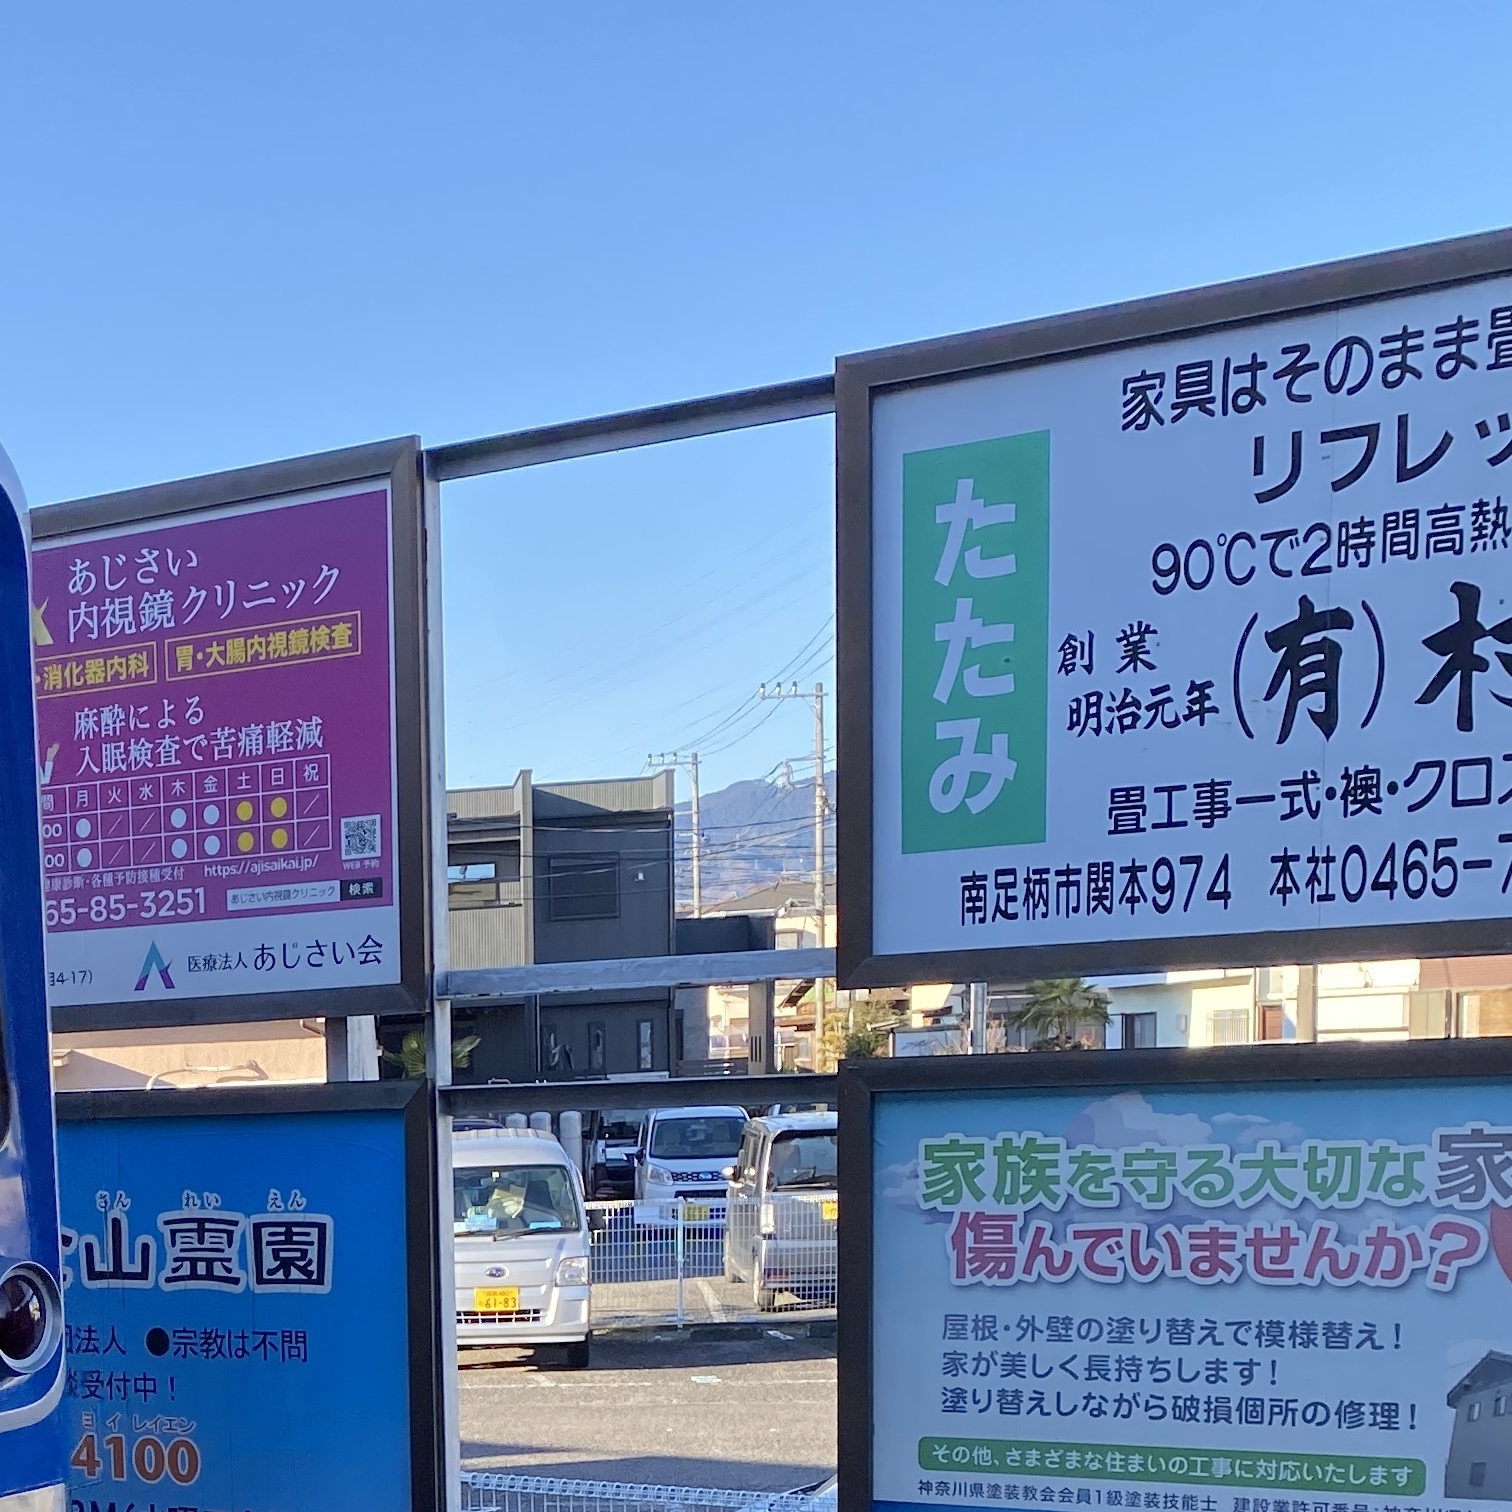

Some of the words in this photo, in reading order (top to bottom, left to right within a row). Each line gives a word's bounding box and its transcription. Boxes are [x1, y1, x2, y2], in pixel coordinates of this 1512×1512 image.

[1252, 412, 1512, 504] リフレッ
[68, 547, 199, 597] あじさい
[67, 563, 340, 643] 内視鏡クリニック
[175, 622, 353, 673] 胃・大腸内視鏡検査
[929, 477, 1018, 815] たたみ
[1057, 620, 1159, 677] 創業
[74, 695, 205, 741] 麻酔による
[1066, 678, 1220, 739] 明治元年
[75, 715, 324, 776] 入眠検査で苦痛軽減
[76, 789, 88, 808] 月
[108, 785, 121, 804] 火
[139, 782, 153, 800] 水
[170, 779, 185, 797] 木
[203, 774, 219, 793] 金
[236, 771, 251, 789] 土
[271, 768, 284, 786] 日
[302, 763, 319, 782] 祝
[960, 852, 1232, 927] 南足柄市関本974
[188, 951, 248, 974] 医療法人
[254, 934, 383, 972] あじさい会
[920, 1127, 1512, 1207] 家族を守る大切な家
[96, 1190, 131, 1211] さん
[182, 1189, 221, 1210] れい
[267, 1188, 305, 1211] えん
[61, 1213, 331, 1291] 山霊園
[951, 1211, 1481, 1287] 傷んでいませんか?
[942, 1313, 1403, 1352] 屋根・外壁の塗り替えで模様替え!
[942, 1350, 1278, 1387] 家が美しく長持ちします!
[132, 1413, 195, 1434] レイエン
[941, 1386, 1418, 1433] 塗り替えしながら破損個所の修理!
[70, 1434, 201, 1487] 4100
[931, 1443, 1414, 1489] その他、さまざまな住まいの工事に対応いたします
